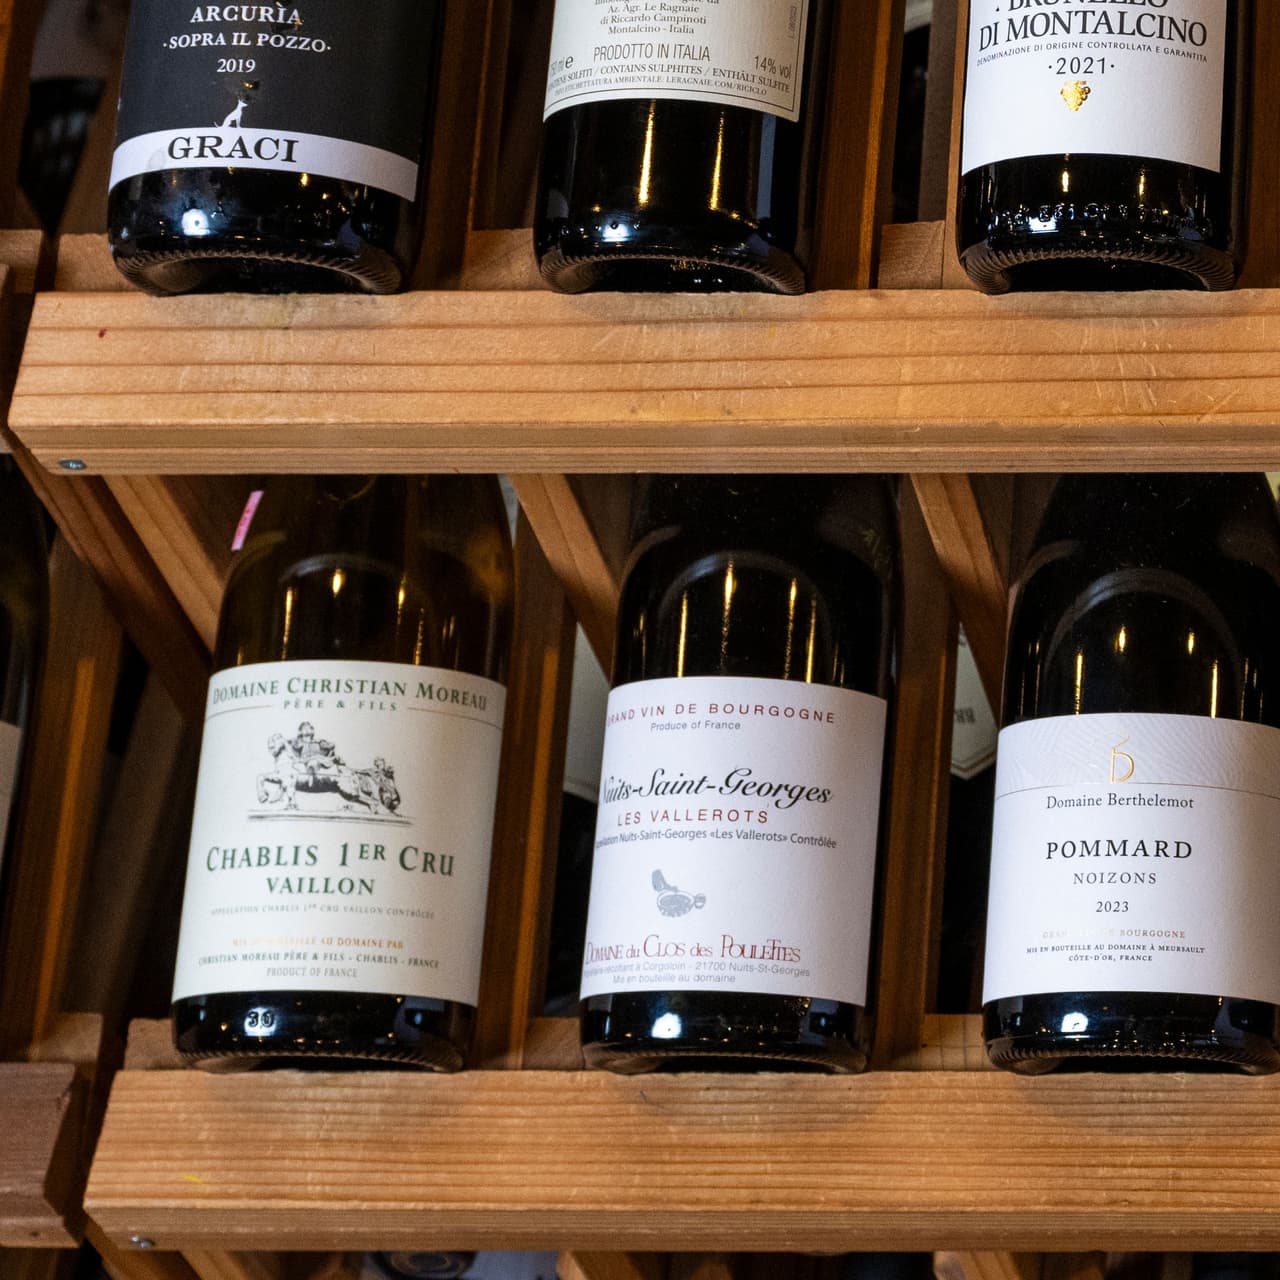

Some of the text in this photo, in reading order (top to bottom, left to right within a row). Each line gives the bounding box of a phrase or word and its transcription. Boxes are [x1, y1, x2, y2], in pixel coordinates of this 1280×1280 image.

[190, 3, 303, 26] ARCURÌA
[978, 9, 1208, 53] DI MONTALCINO
[216, 58, 256, 73] 2019
[168, 135, 300, 163] GRACI
[212, 676, 487, 712] DOMAINE CHRISTIAN MOREAU
[1046, 793, 1194, 810] Domaine Berthelemot
[617, 809, 769, 828] LES VALLEROTS
[1046, 839, 1194, 861] POMMARD
[206, 845, 319, 872] CHABLIS
[398, 845, 455, 877] CRU
[266, 877, 376, 896] VAILLON
[1073, 872, 1157, 885] NOIZONS
[1095, 901, 1129, 914] 2023
